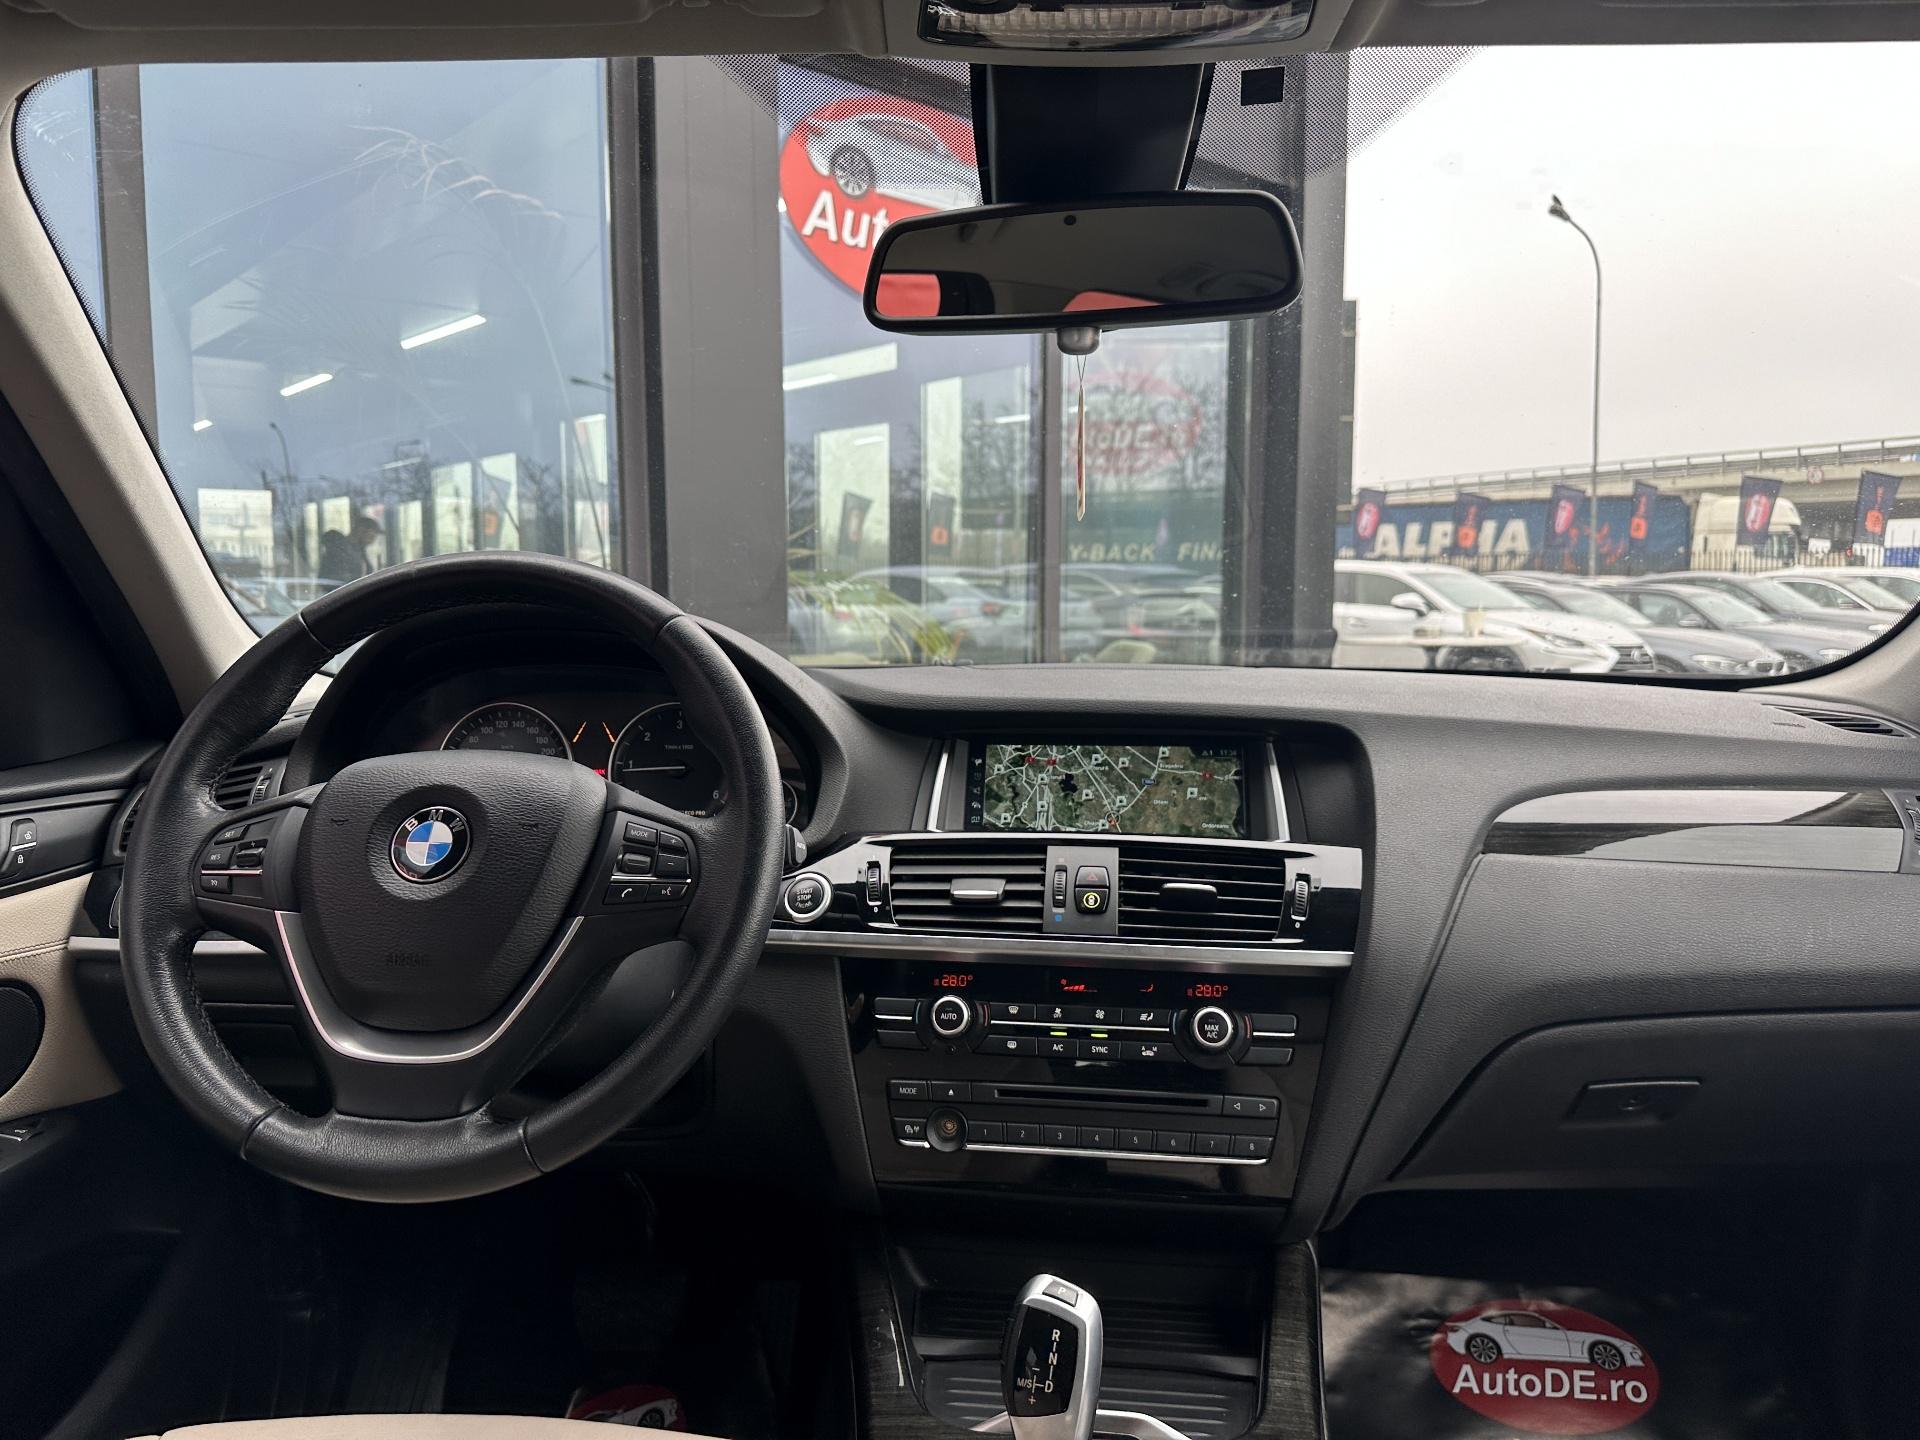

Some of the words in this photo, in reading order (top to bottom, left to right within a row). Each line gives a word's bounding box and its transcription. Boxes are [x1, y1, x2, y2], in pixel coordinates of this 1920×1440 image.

[676, 720, 683, 729] 3
[644, 731, 651, 741] 2
[713, 790, 719, 799] 6
[404, 809, 465, 832] BMW
[224, 830, 236, 839] SET
[630, 829, 649, 838] MODE
[796, 887, 814, 896] START
[796, 894, 812, 902] STOP
[940, 1012, 957, 1020] AUTO
[1204, 1023, 1219, 1032] MAX
[1206, 1031, 1218, 1039] A/C
[1052, 1043, 1064, 1051] A/C
[1091, 1045, 1109, 1054] SYNC
[899, 1087, 918, 1095] MODE
[1020, 1130, 1025, 1138] 2
[1057, 1132, 1062, 1140] 3
[1094, 1134, 1099, 1142] 4
[1133, 1136, 1138, 1144] 5
[1170, 1138, 1176, 1146] 6
[1210, 1140, 1215, 1148] 7
[1057, 1286, 1066, 1295] P
[1051, 1328, 1061, 1342] R
[1048, 1352, 1058, 1366] N
[1016, 1377, 1033, 1389] M/S
[1044, 1380, 1054, 1393] D
[1452, 1363, 1648, 1403] AutoDE.ro
